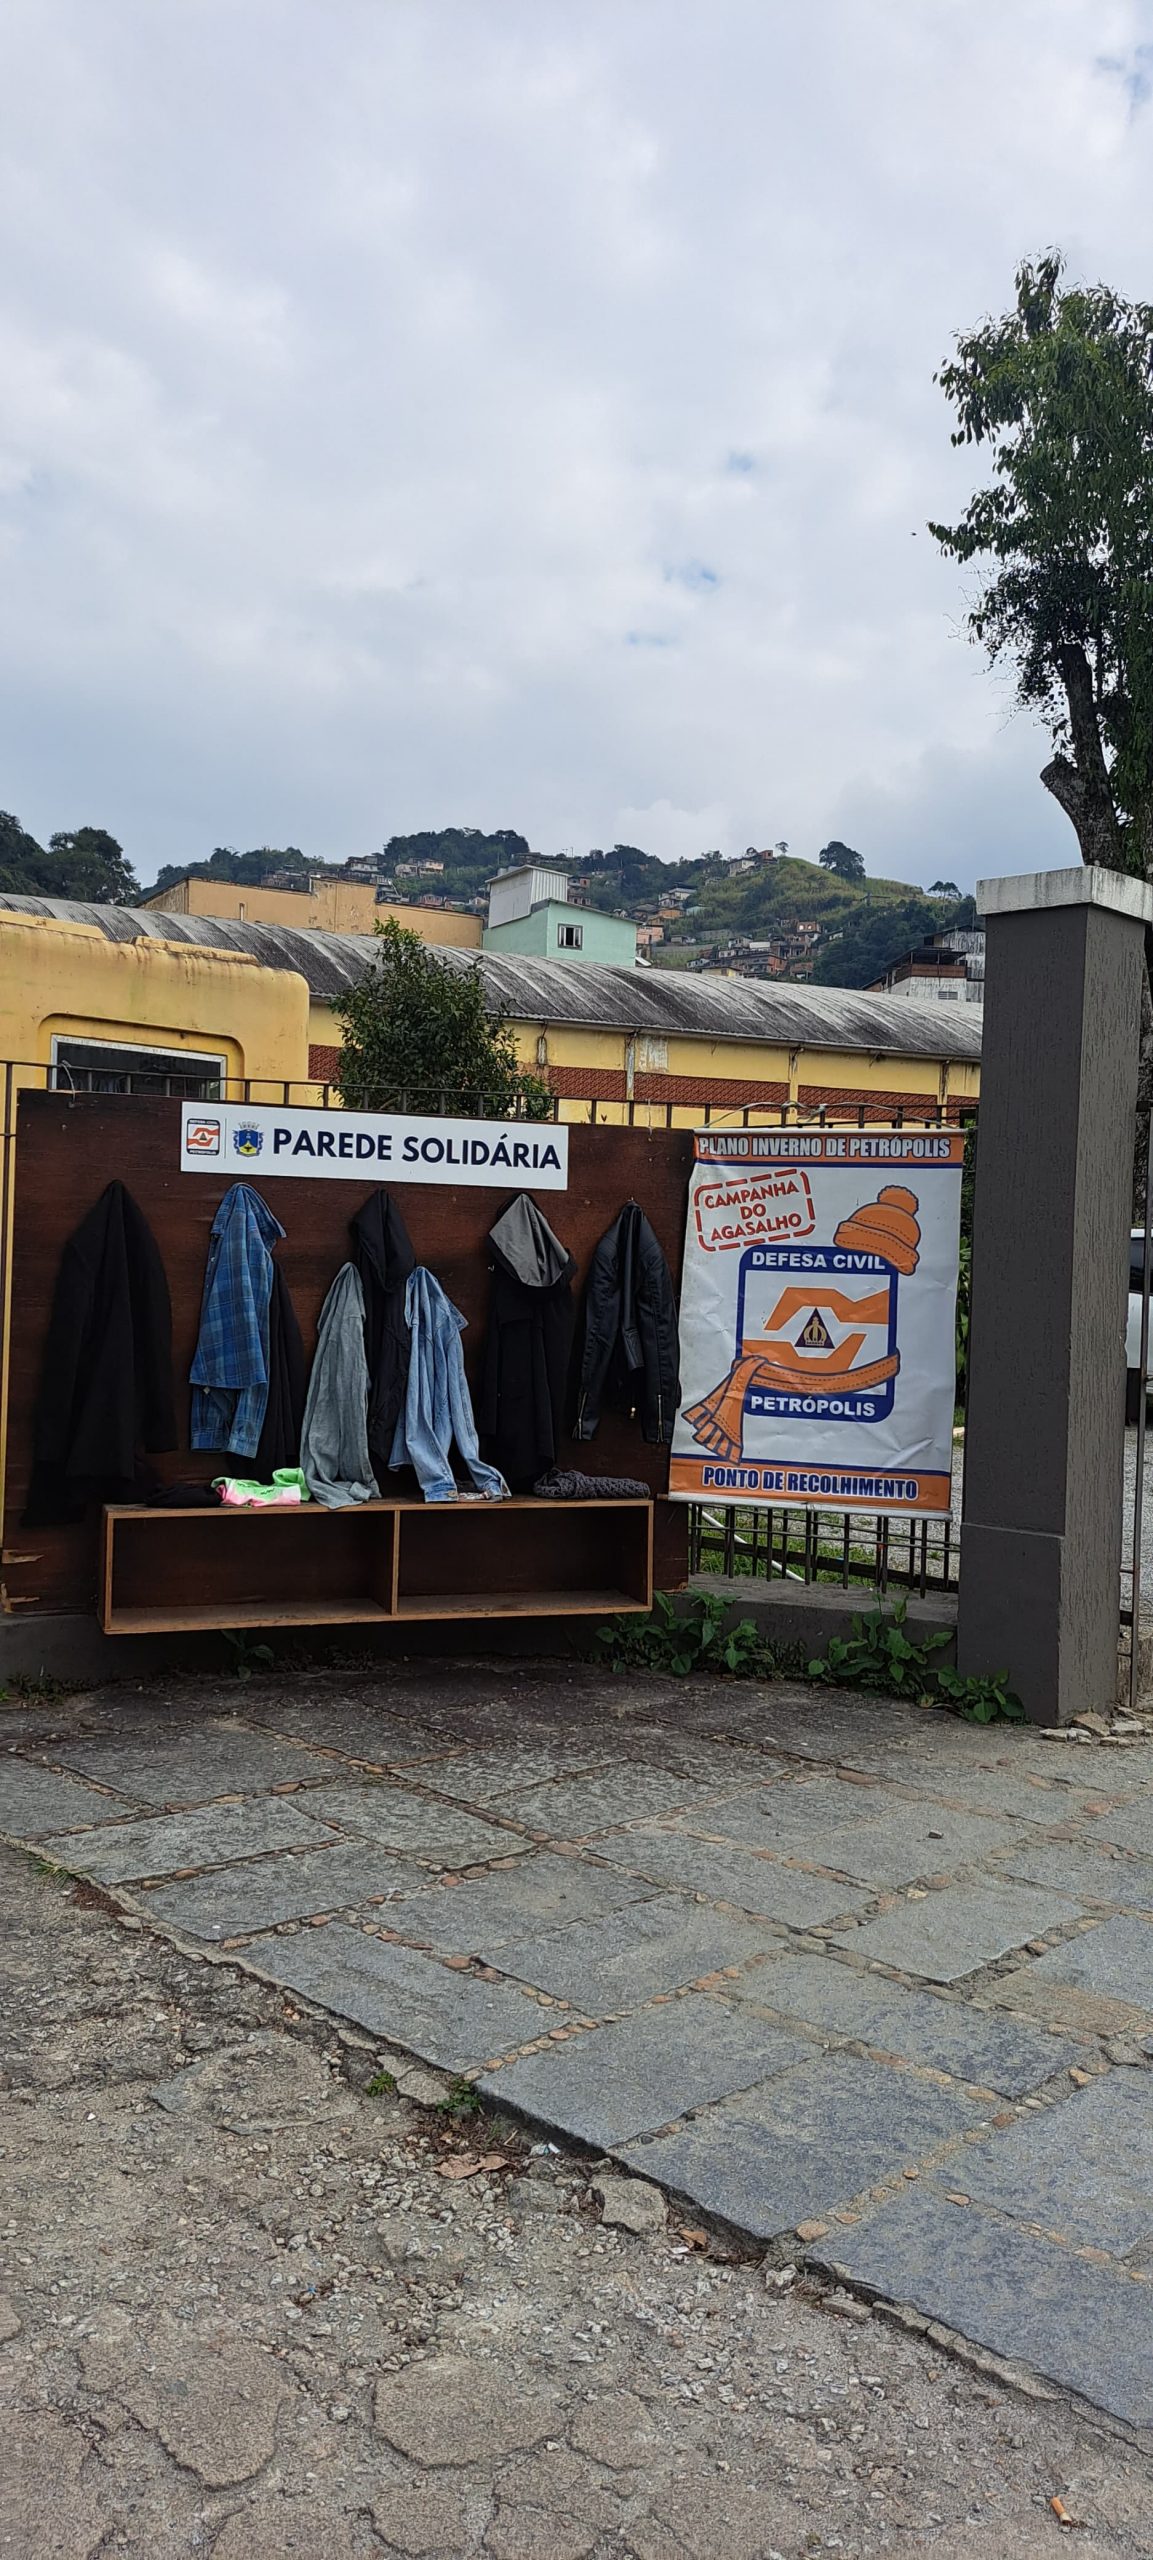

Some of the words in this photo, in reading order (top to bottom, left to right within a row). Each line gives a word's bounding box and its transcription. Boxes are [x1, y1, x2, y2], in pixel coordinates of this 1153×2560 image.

[273, 1128, 393, 1161] PAREDE
[402, 1133, 562, 1170] SOLIDÁRIA
[699, 1137, 749, 1156] PLANO
[752, 1138, 822, 1158] INVERNO
[825, 1138, 847, 1158] DE
[850, 1136, 951, 1159] PETRÓPOLIS
[704, 1179, 800, 1209] CAMPANHA
[740, 1203, 767, 1220] DO
[710, 1212, 802, 1242] AGASALHO
[752, 1251, 828, 1268] DEFESA
[833, 1254, 886, 1270] CIVIL
[751, 1395, 876, 1418] PETRÓPOLIS
[703, 1466, 760, 1490] PONTO
[762, 1470, 784, 1491] DE
[787, 1473, 919, 1500] RECOLHIMENTO
